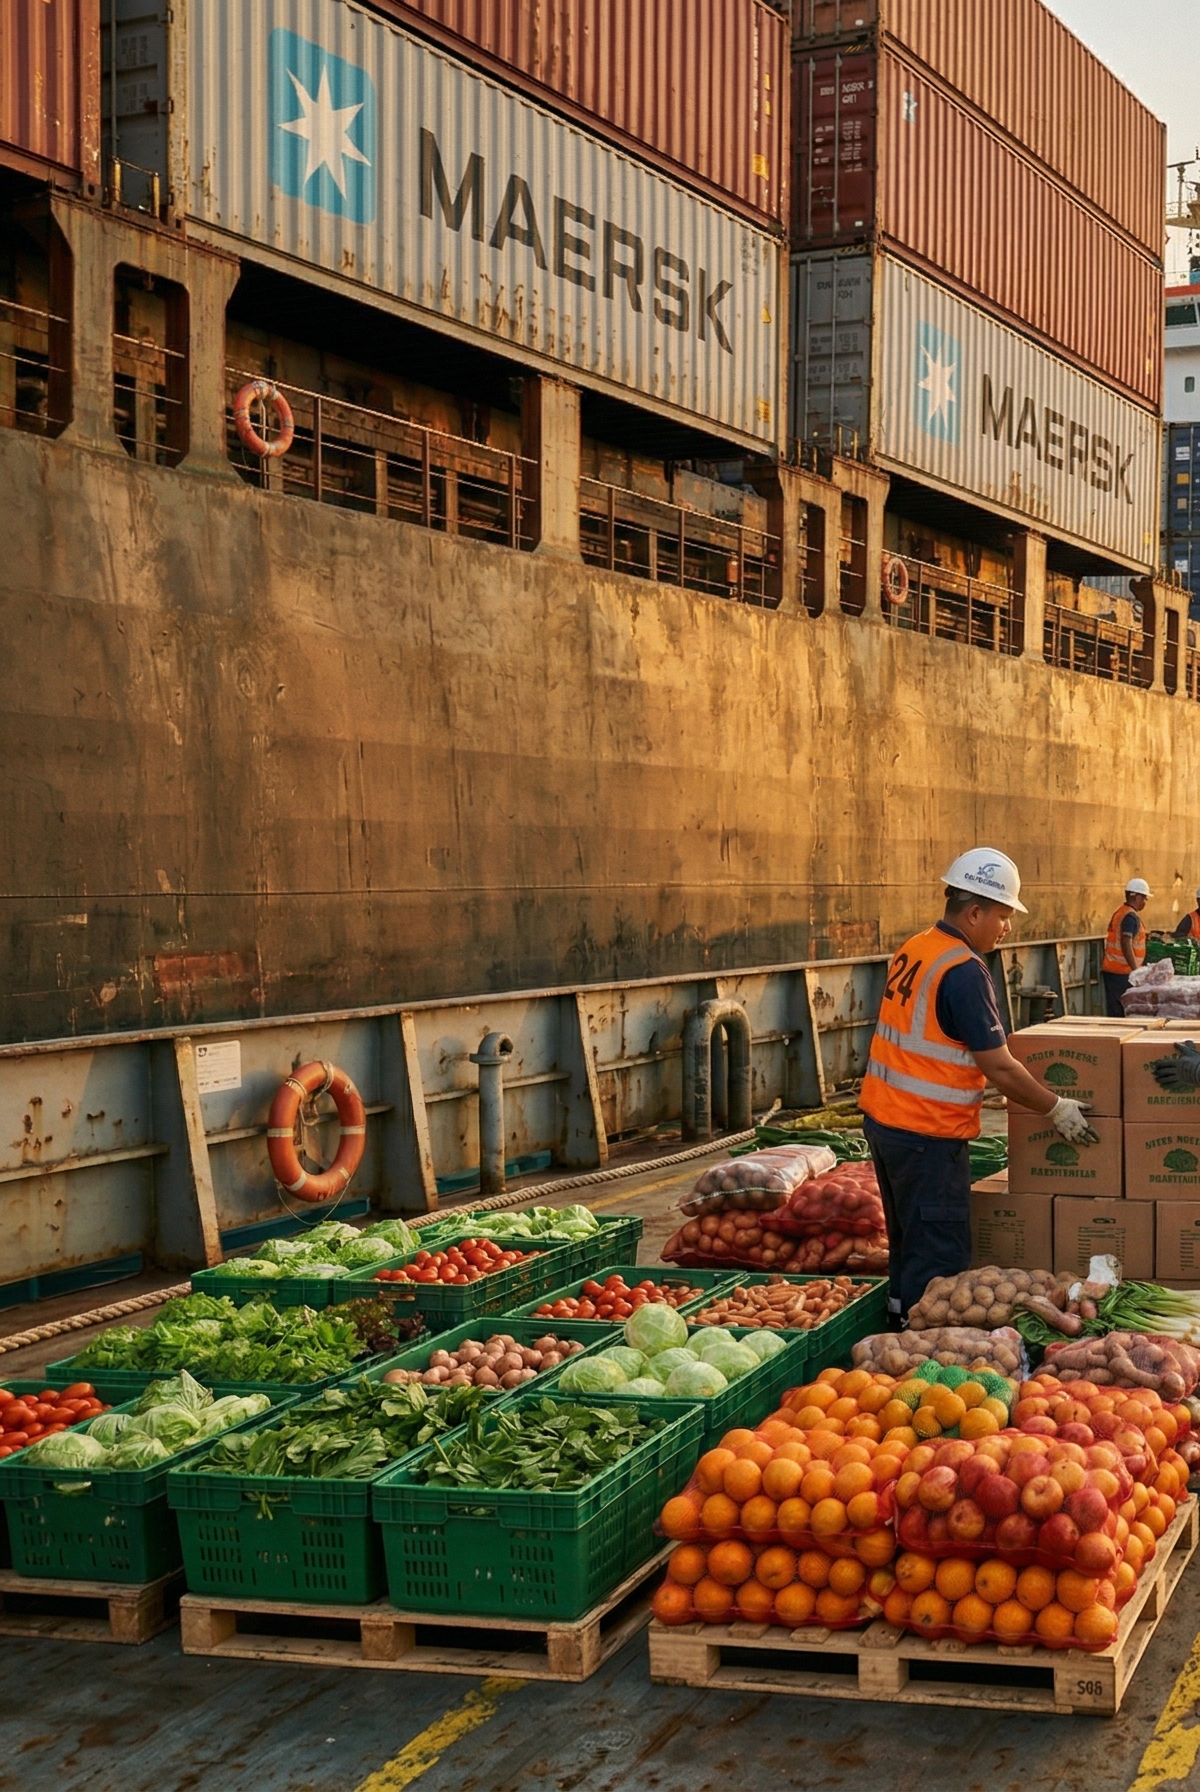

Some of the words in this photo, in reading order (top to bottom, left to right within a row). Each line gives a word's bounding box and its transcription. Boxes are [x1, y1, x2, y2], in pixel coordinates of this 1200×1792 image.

[420, 127, 735, 355] MAERSK
[981, 374, 1134, 505] MAERSK
[885, 953, 922, 1007] 24
